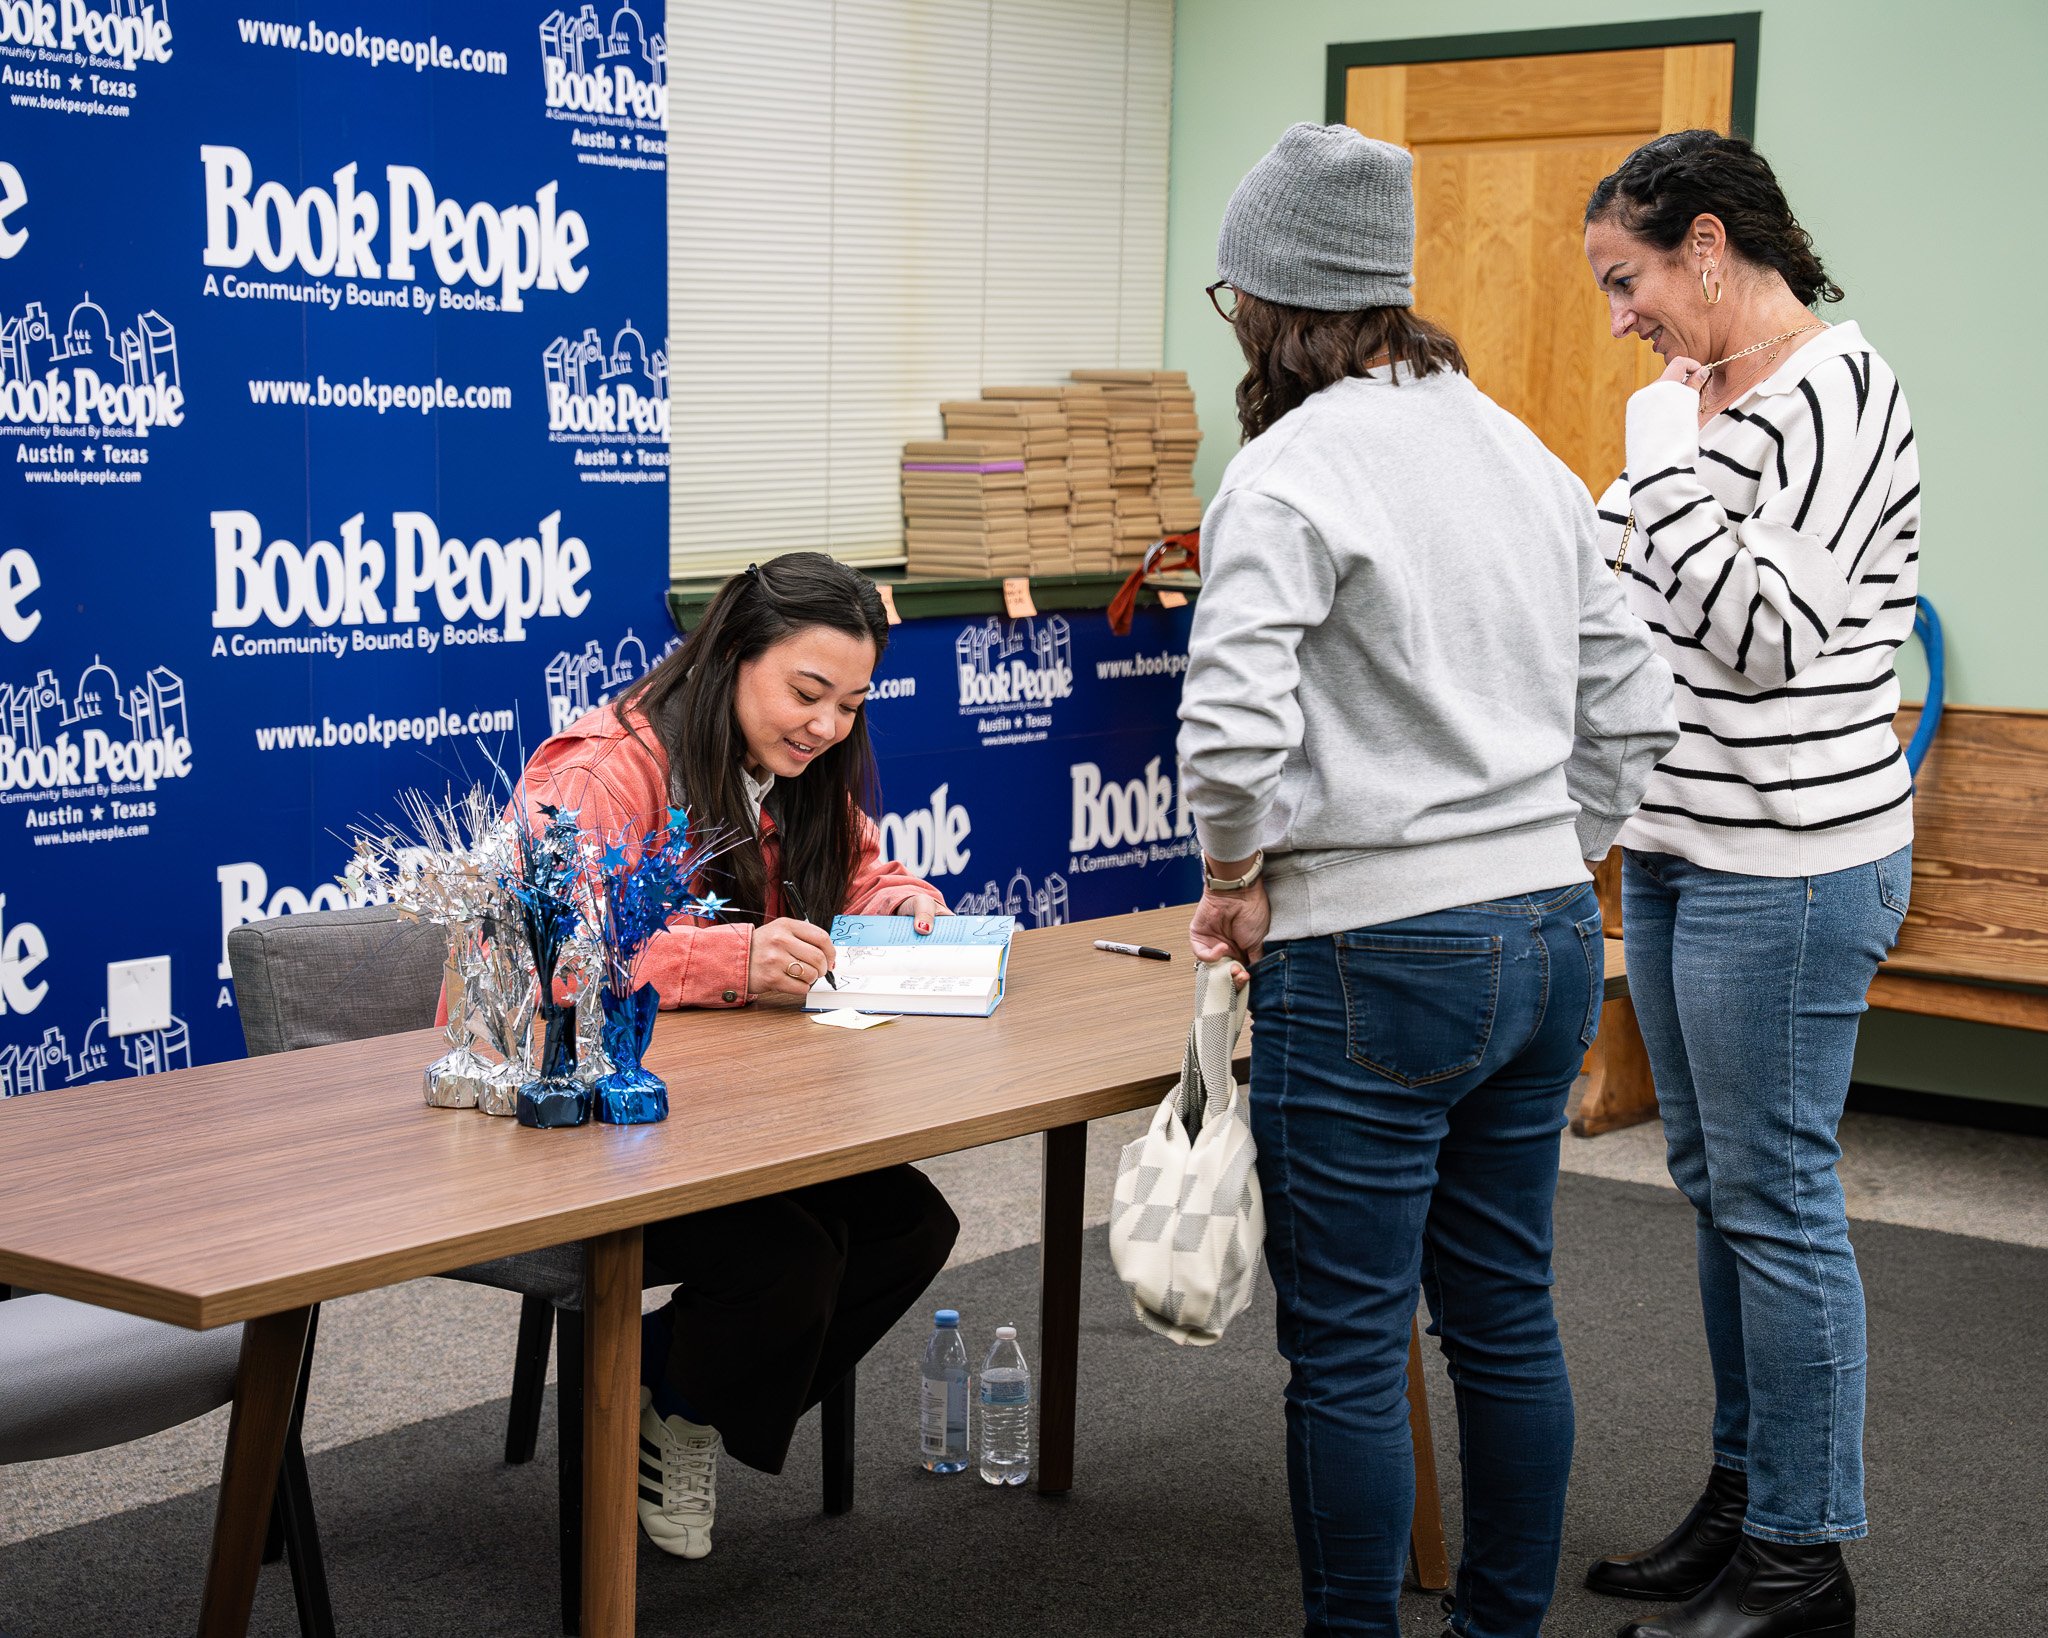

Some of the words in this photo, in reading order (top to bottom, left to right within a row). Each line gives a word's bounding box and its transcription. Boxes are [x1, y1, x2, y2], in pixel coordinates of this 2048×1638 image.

[61, 0, 173, 71] People
[237, 18, 507, 75] www.bookpeople.com
[39, 48, 73, 63] Bound
[74, 52, 87, 68] By
[1, 64, 61, 90] Austin
[89, 74, 137, 99] Texas
[545, 56, 614, 114] Book
[10, 94, 130, 118] www.bookpeople.com
[571, 127, 616, 150] Austin
[200, 144, 381, 280] Book
[387, 164, 590, 313] People
[203, 273, 219, 297] A
[222, 274, 342, 311] Community
[345, 283, 409, 309] Bound
[412, 286, 436, 315] By
[439, 287, 501, 312] Books.
[0, 367, 72, 424] ook
[73, 368, 185, 437] People
[248, 376, 512, 414] www.bookpeople.com
[548, 381, 616, 432] Book
[53, 425, 87, 437] Bound
[88, 425, 101, 440] By
[16, 443, 75, 464] Austin
[102, 444, 149, 464] Texas
[574, 448, 617, 466] Austin
[25, 468, 142, 485] www.bookpeople.com
[210, 510, 386, 627] Book
[393, 510, 591, 642] People
[211, 635, 227, 657] A
[231, 632, 348, 659] Community
[352, 627, 413, 651] Bound
[417, 627, 440, 653] By
[443, 623, 504, 645] Books.
[959, 661, 1011, 705] Book
[1011, 657, 1073, 707] People
[256, 707, 513, 751] www.bookpeople.com
[977, 715, 1011, 733] Austin
[1024, 713, 1052, 728] Texas
[83, 724, 192, 791] People
[0, 788, 60, 804] Community
[62, 784, 95, 799] Bound
[97, 783, 110, 799] By
[26, 805, 83, 828] Austin
[111, 801, 156, 820] Texas
[34, 824, 149, 846] www.bookpeople.com
[1069, 856, 1079, 874] A
[1079, 846, 1148, 871] Community
[217, 986, 233, 1008] A
